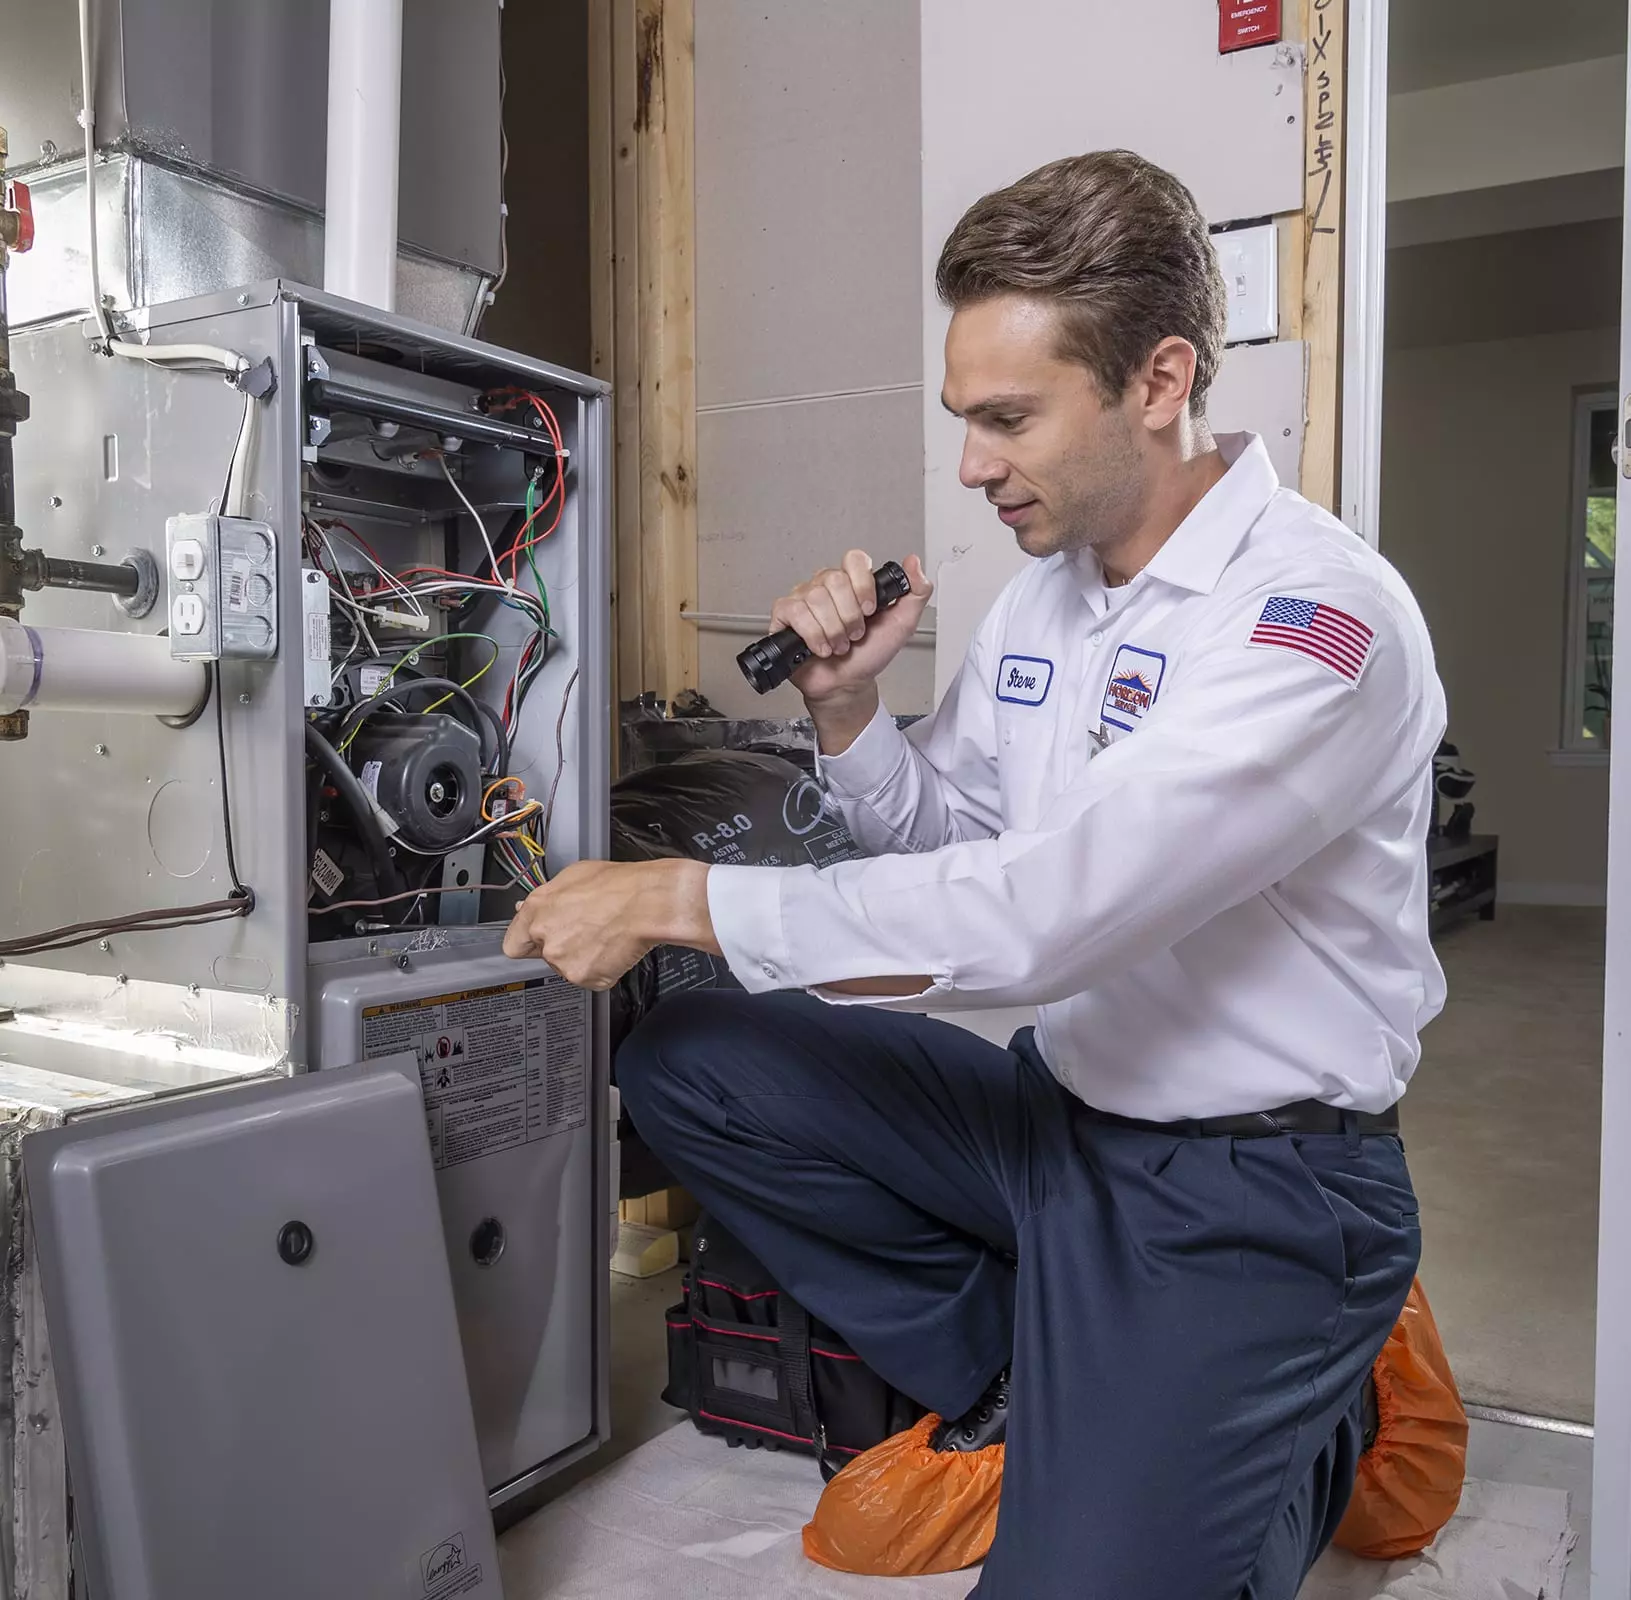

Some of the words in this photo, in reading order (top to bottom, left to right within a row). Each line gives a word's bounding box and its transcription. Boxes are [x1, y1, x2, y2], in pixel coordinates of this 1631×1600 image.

[1230, 5, 1268, 19] EMERGENCY
[1237, 25, 1260, 35] SWITCH
[1007, 667, 1036, 690] Steve
[1109, 682, 1150, 708] HORIZON
[692, 814, 753, 850] R-8.0
[712, 842, 740, 860] ASTM
[825, 837, 847, 849] MEETS
[719, 851, 746, 865] C-518
